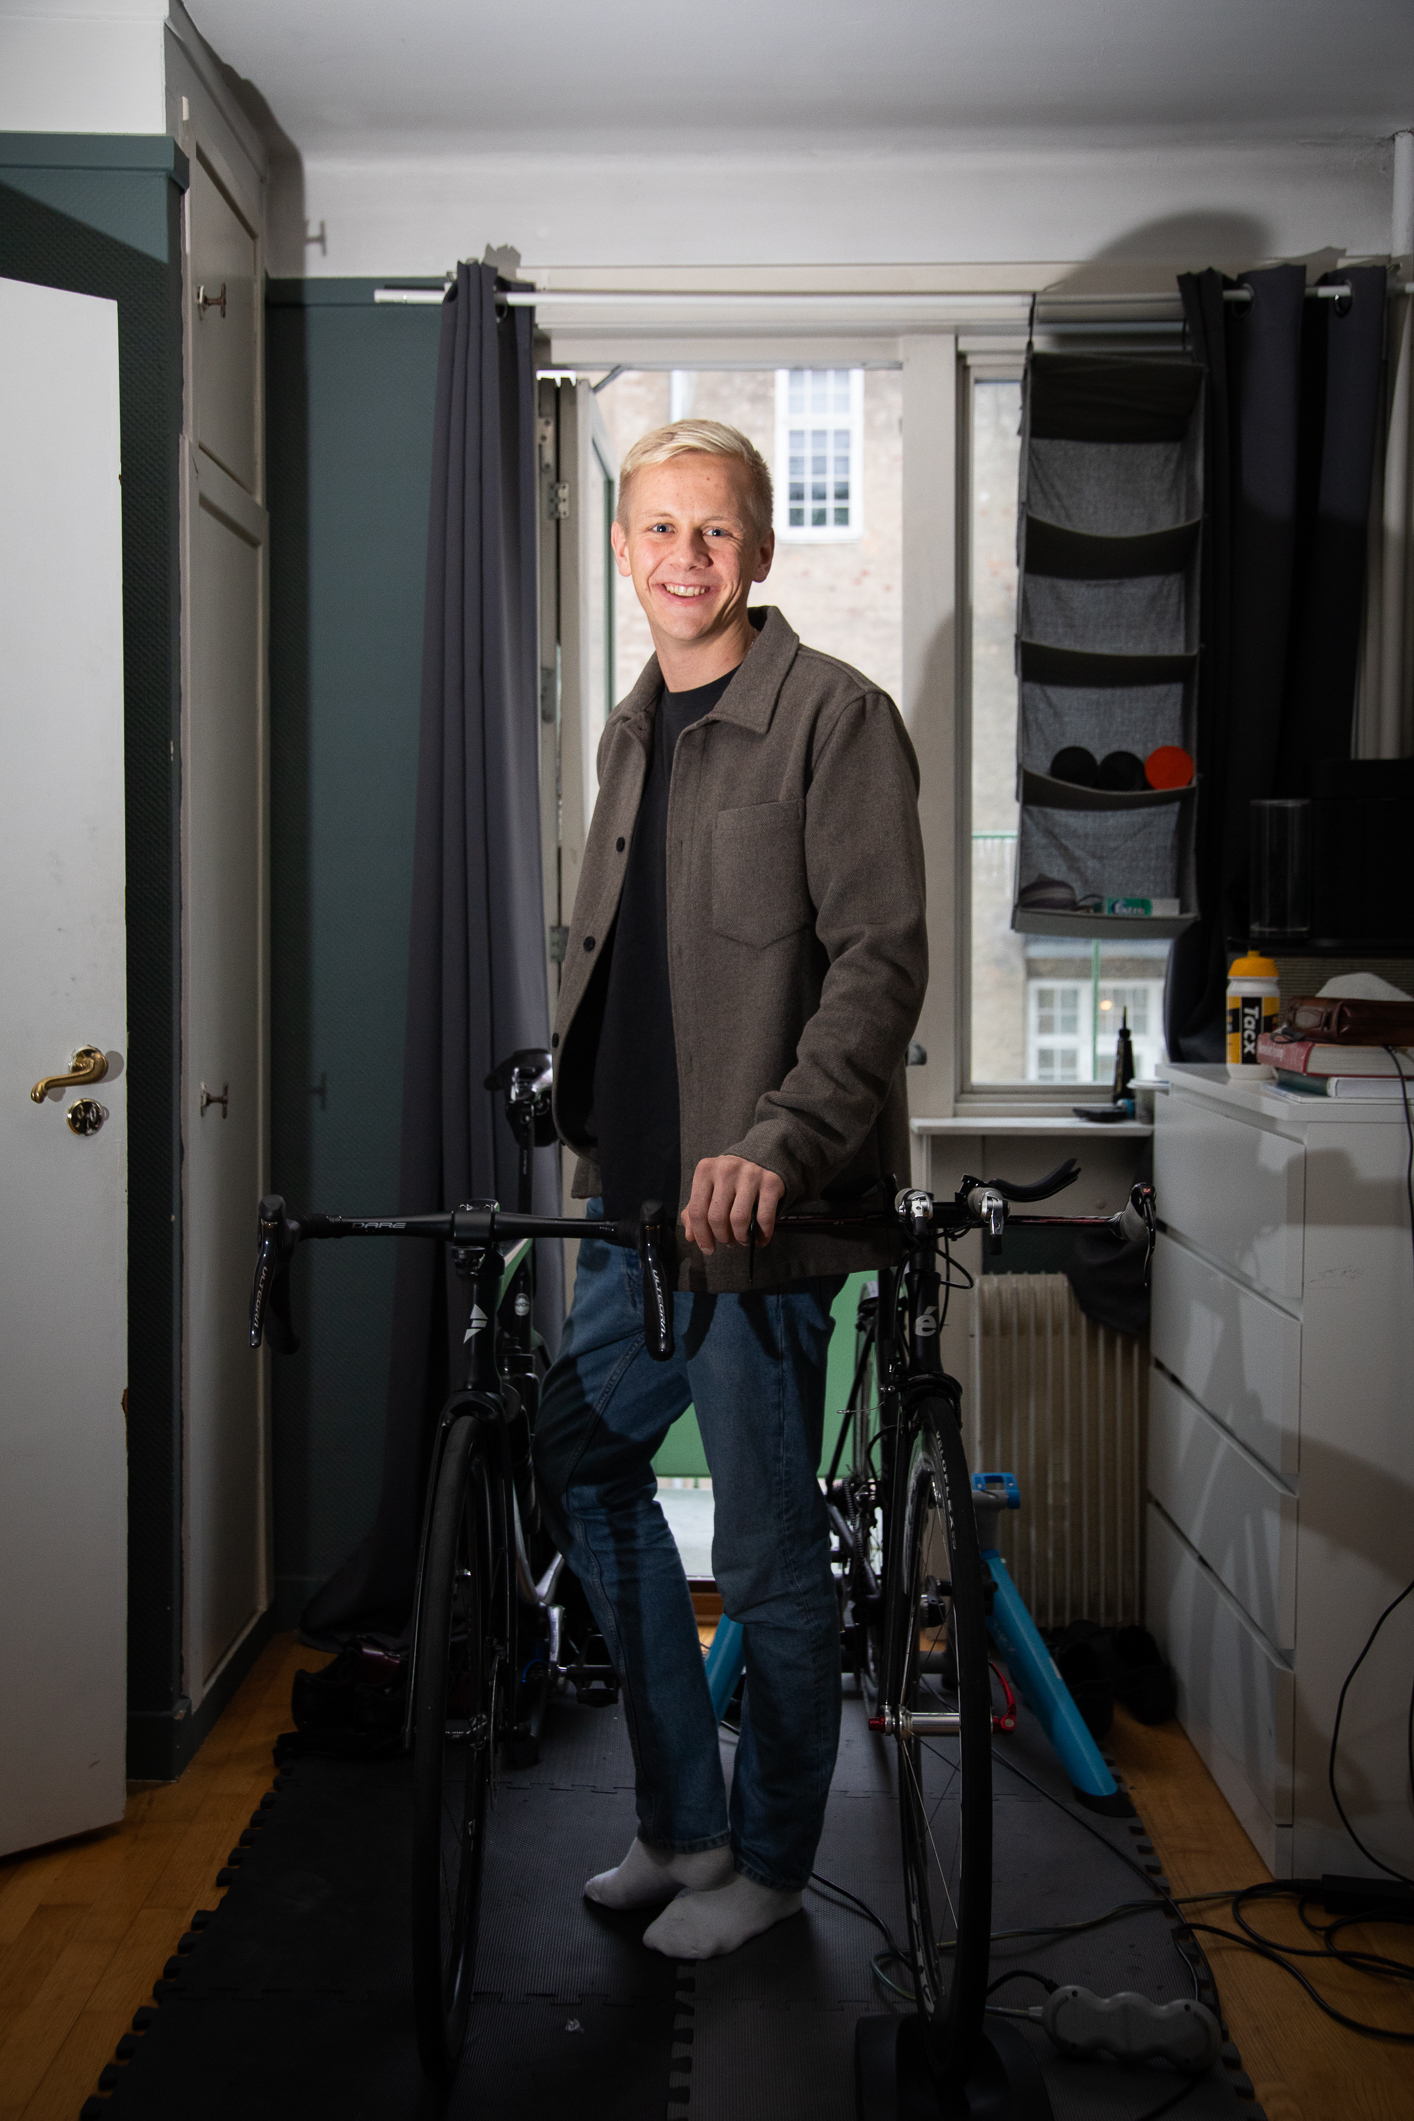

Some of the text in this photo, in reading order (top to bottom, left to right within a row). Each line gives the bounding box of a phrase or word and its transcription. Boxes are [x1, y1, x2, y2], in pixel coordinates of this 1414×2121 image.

[1243, 1005, 1260, 1055] Tacx
[254, 1266, 268, 1329] ULTEGRA
[652, 1269, 667, 1334] ULTEGRA
